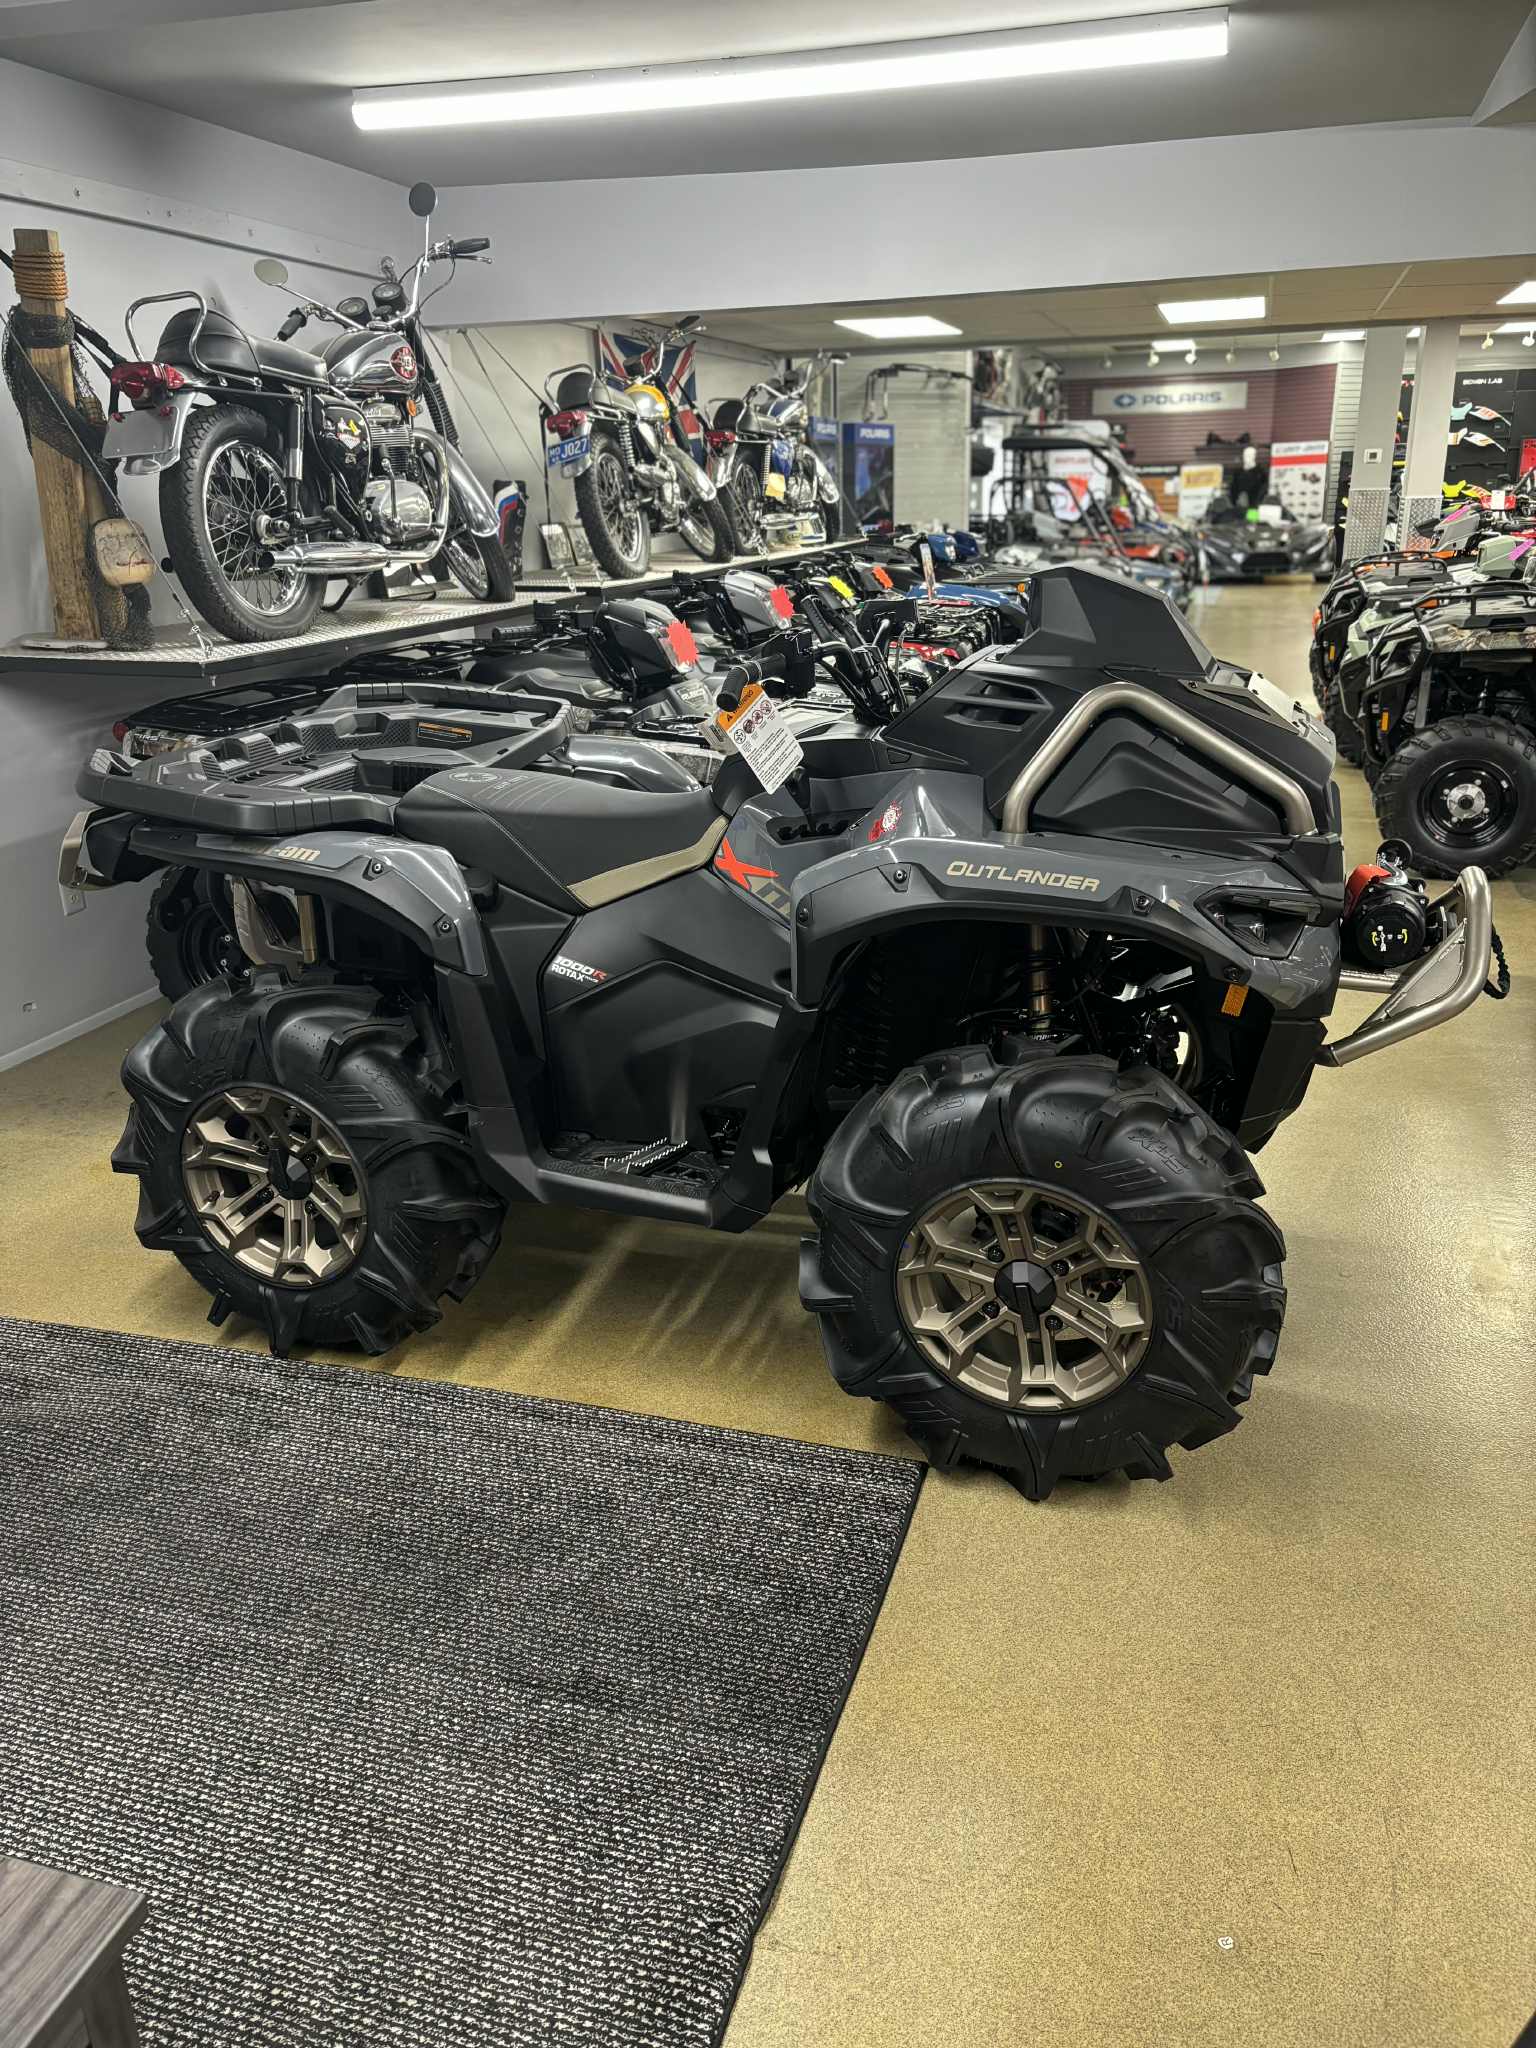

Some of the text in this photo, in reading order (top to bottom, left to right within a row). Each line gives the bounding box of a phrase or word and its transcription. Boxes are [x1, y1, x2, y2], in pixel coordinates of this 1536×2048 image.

[1142, 391, 1222, 406] POLARIS
[561, 438, 588, 458] J027
[946, 860, 1101, 893] OUTLANDER
[551, 963, 585, 982] ROTAX
[554, 954, 608, 981] 1000R
